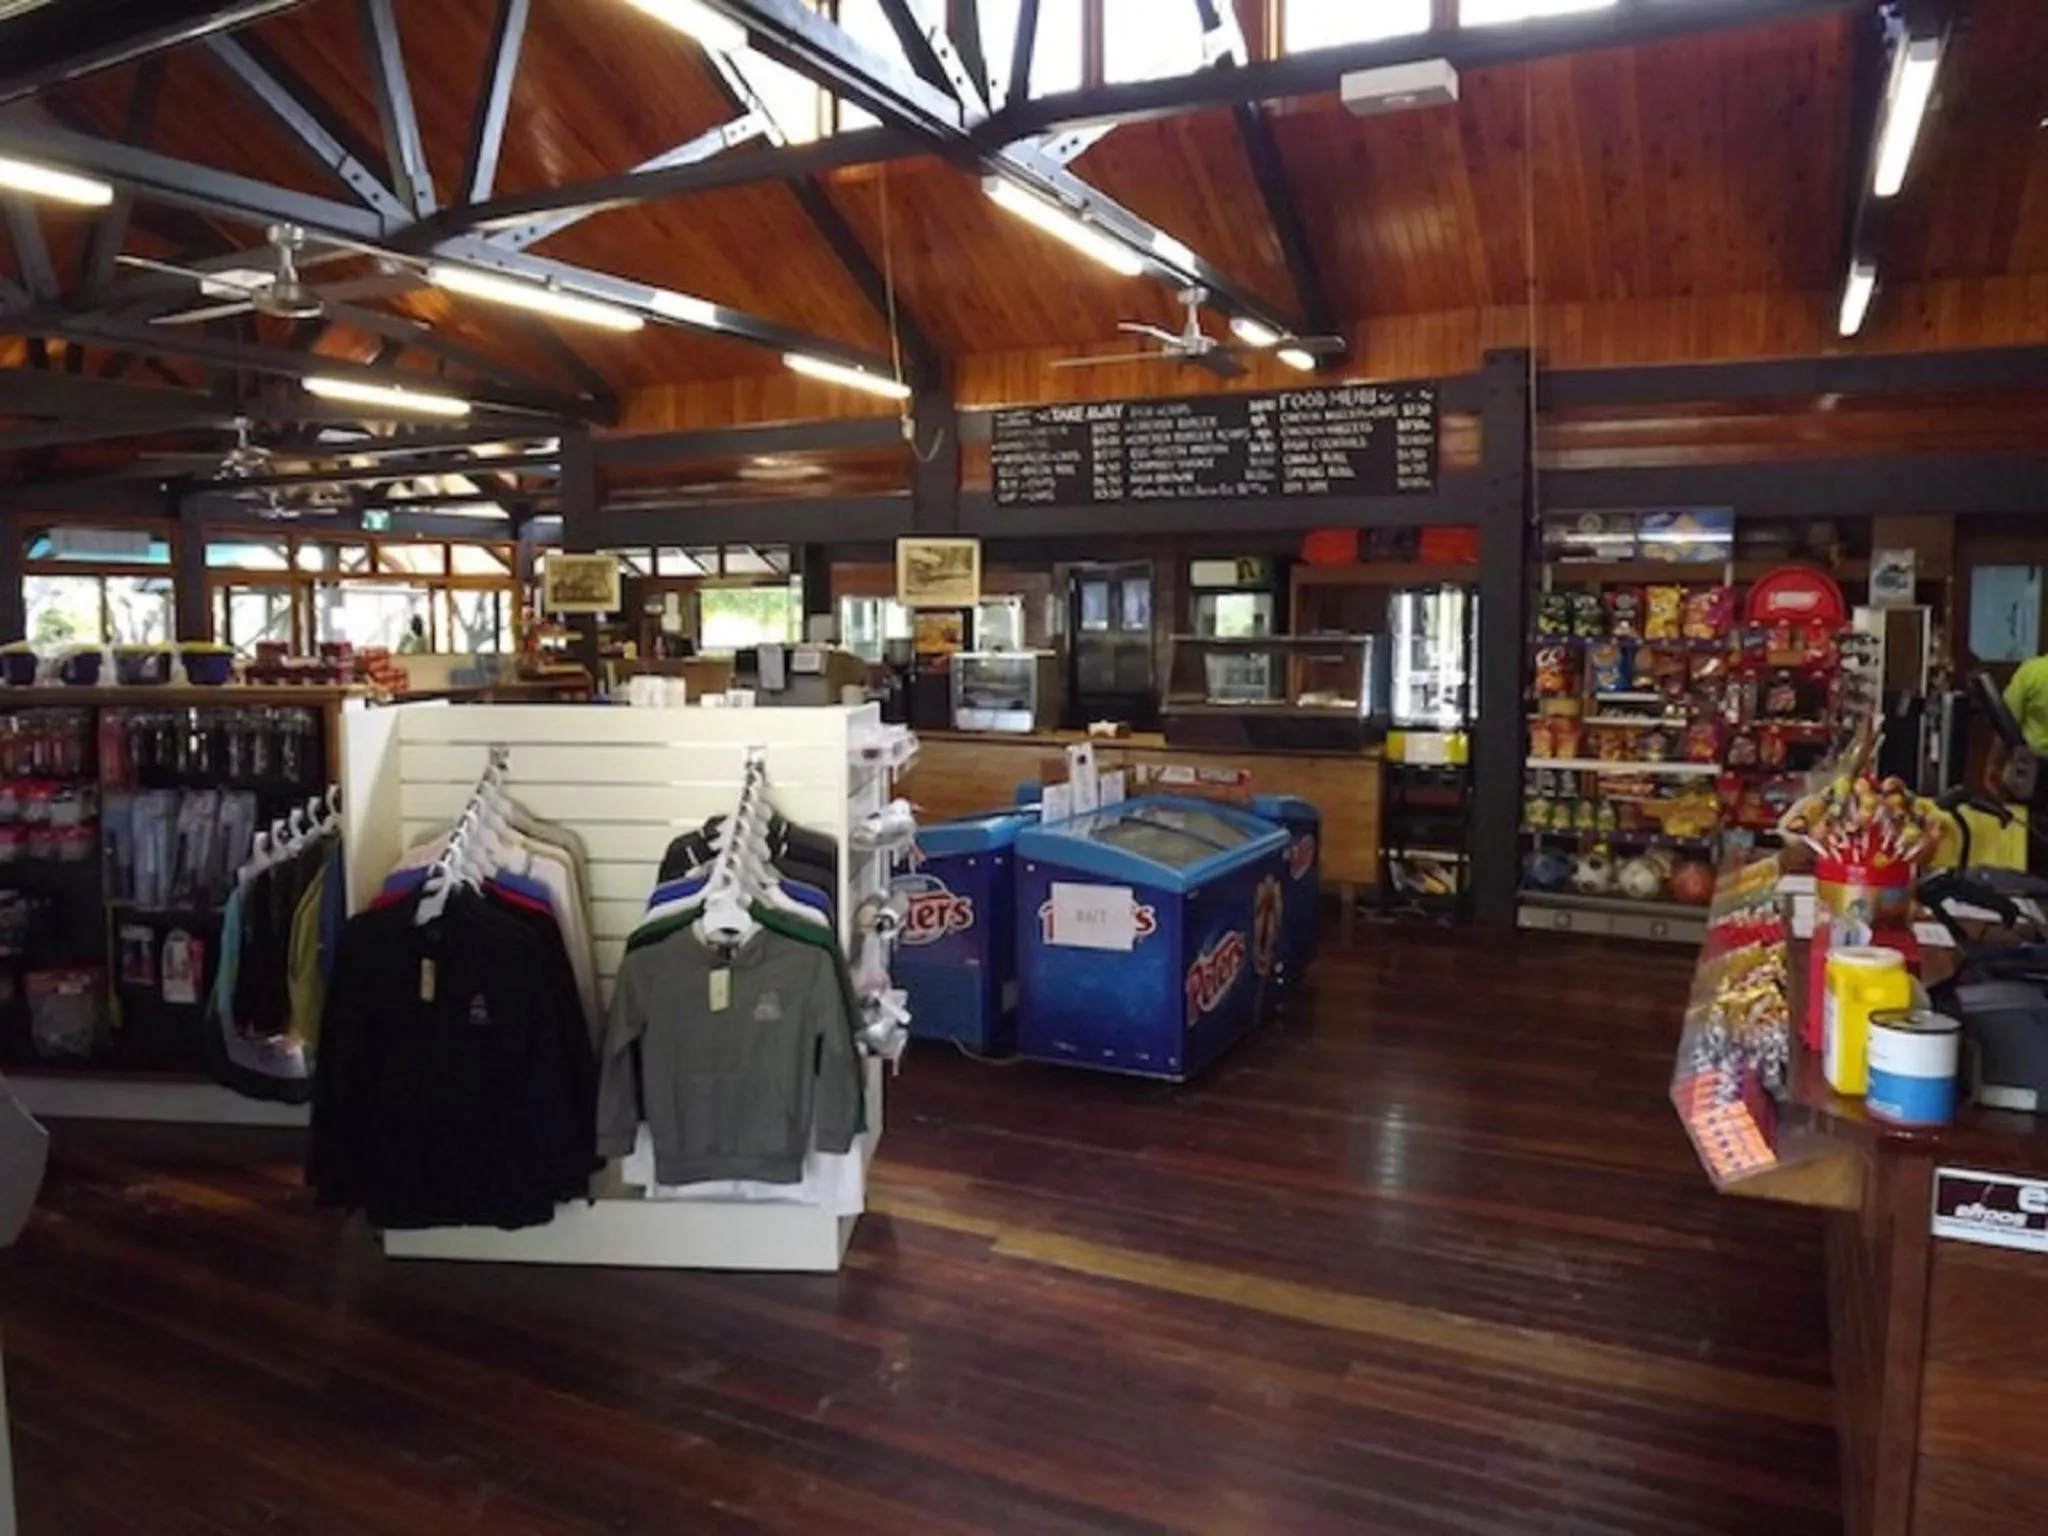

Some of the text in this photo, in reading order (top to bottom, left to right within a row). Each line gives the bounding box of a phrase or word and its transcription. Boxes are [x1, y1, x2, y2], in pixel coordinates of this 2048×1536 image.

[1279, 393, 1326, 411] FOOD
[1328, 388, 1377, 405] MENU
[1052, 405, 1084, 422] TAKE
[1087, 403, 1124, 419] AWAY
